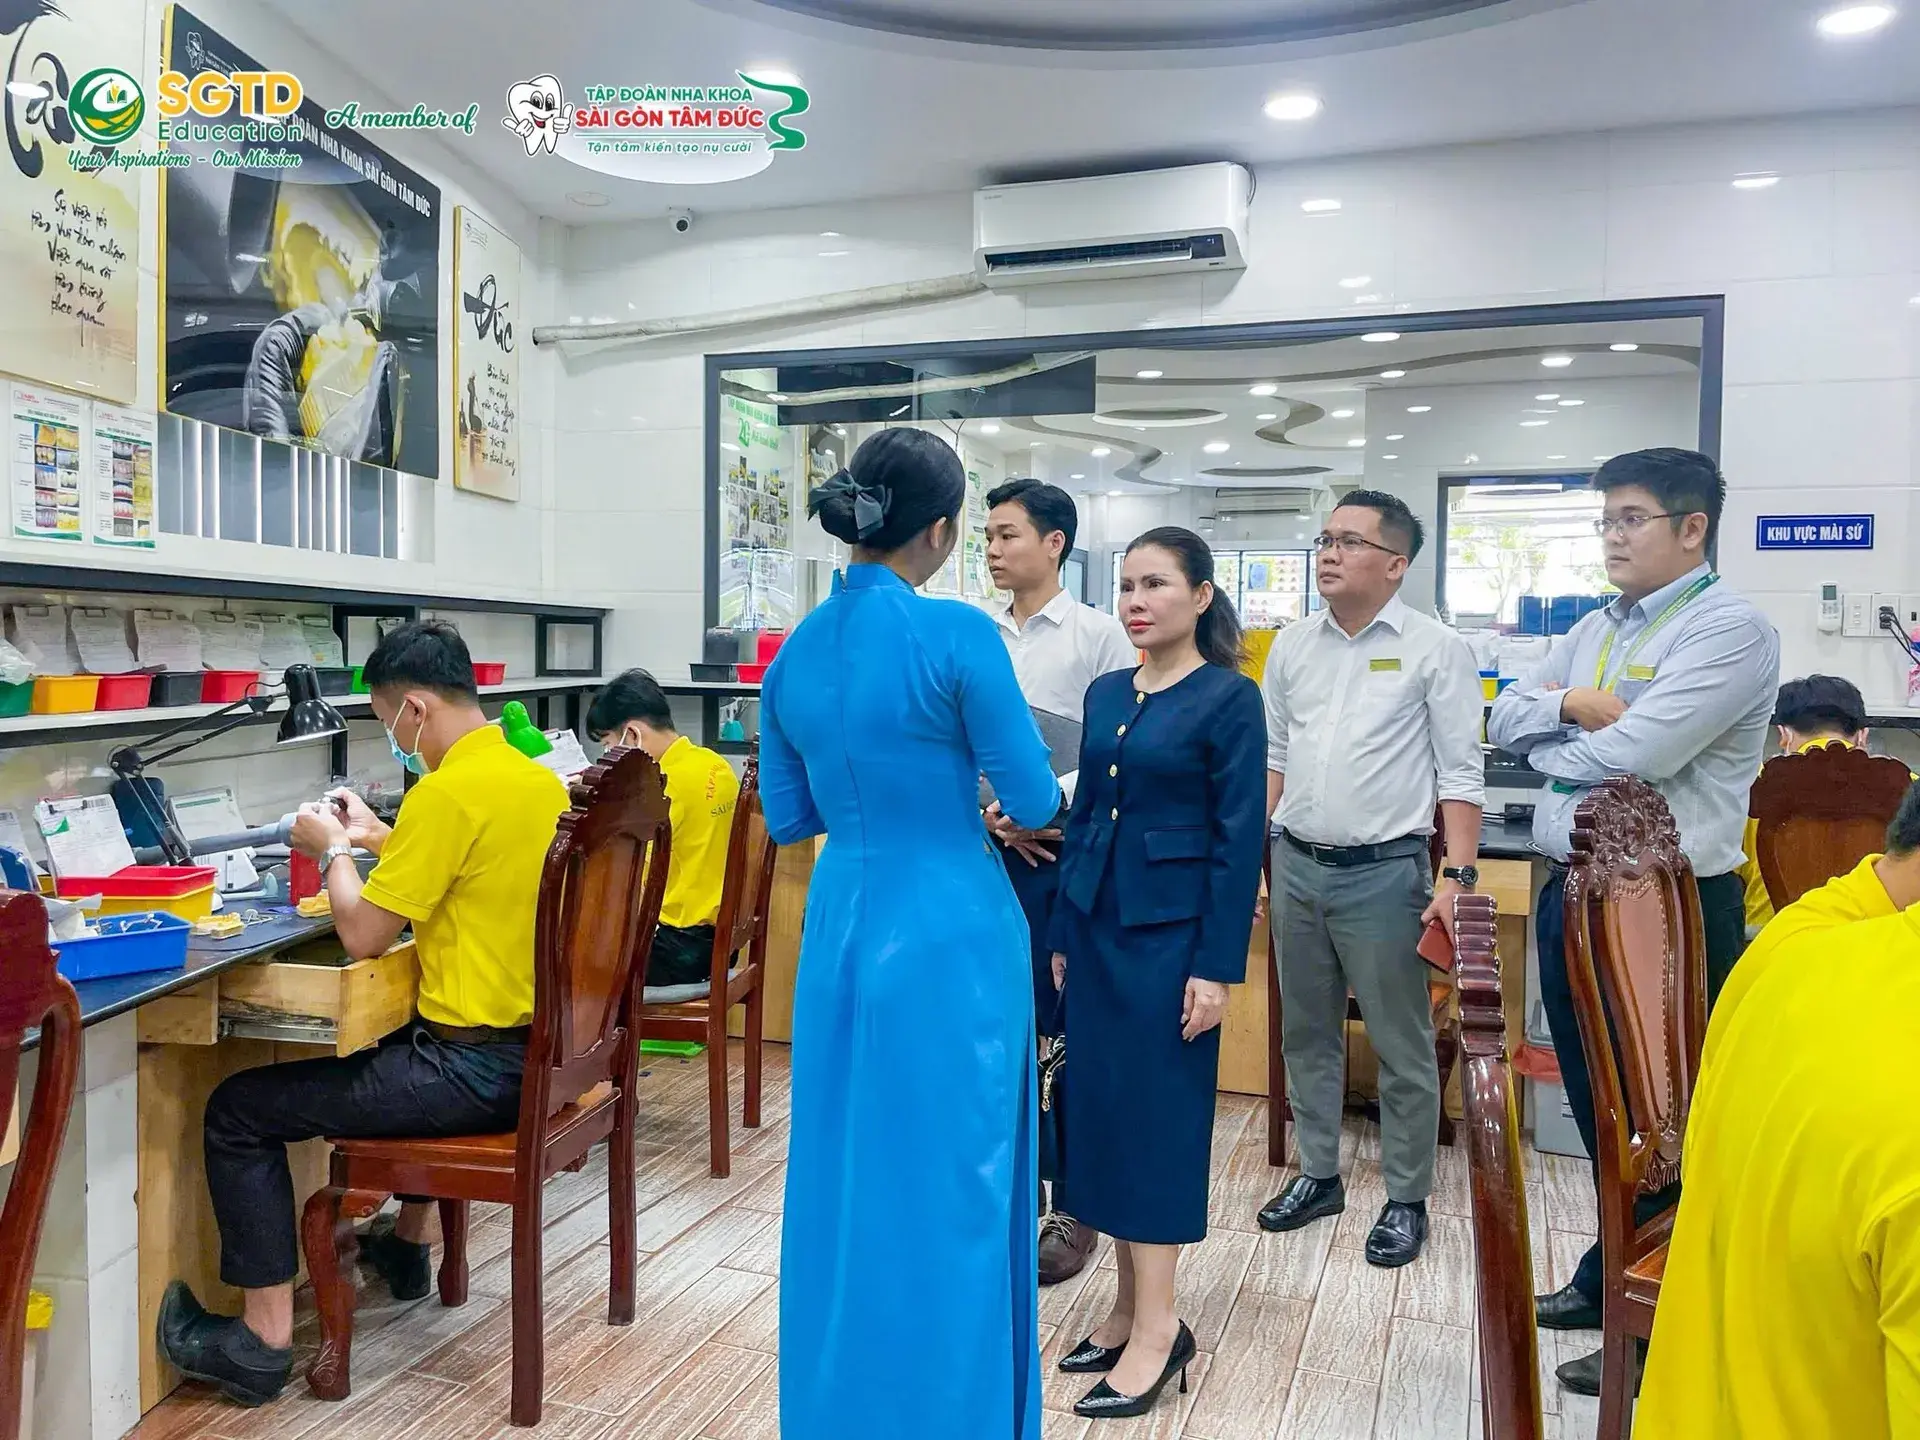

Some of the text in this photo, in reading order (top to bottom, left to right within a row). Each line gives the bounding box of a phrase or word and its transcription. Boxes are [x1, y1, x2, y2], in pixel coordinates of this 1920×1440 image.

[320, 131, 339, 160] NHA
[341, 144, 364, 176] KHOA
[365, 161, 379, 185] SÀI
[380, 170, 397, 197] GÒN
[398, 183, 415, 208] TÂM
[1767, 522, 1864, 544] KHU VỰC MÀI SỨ
